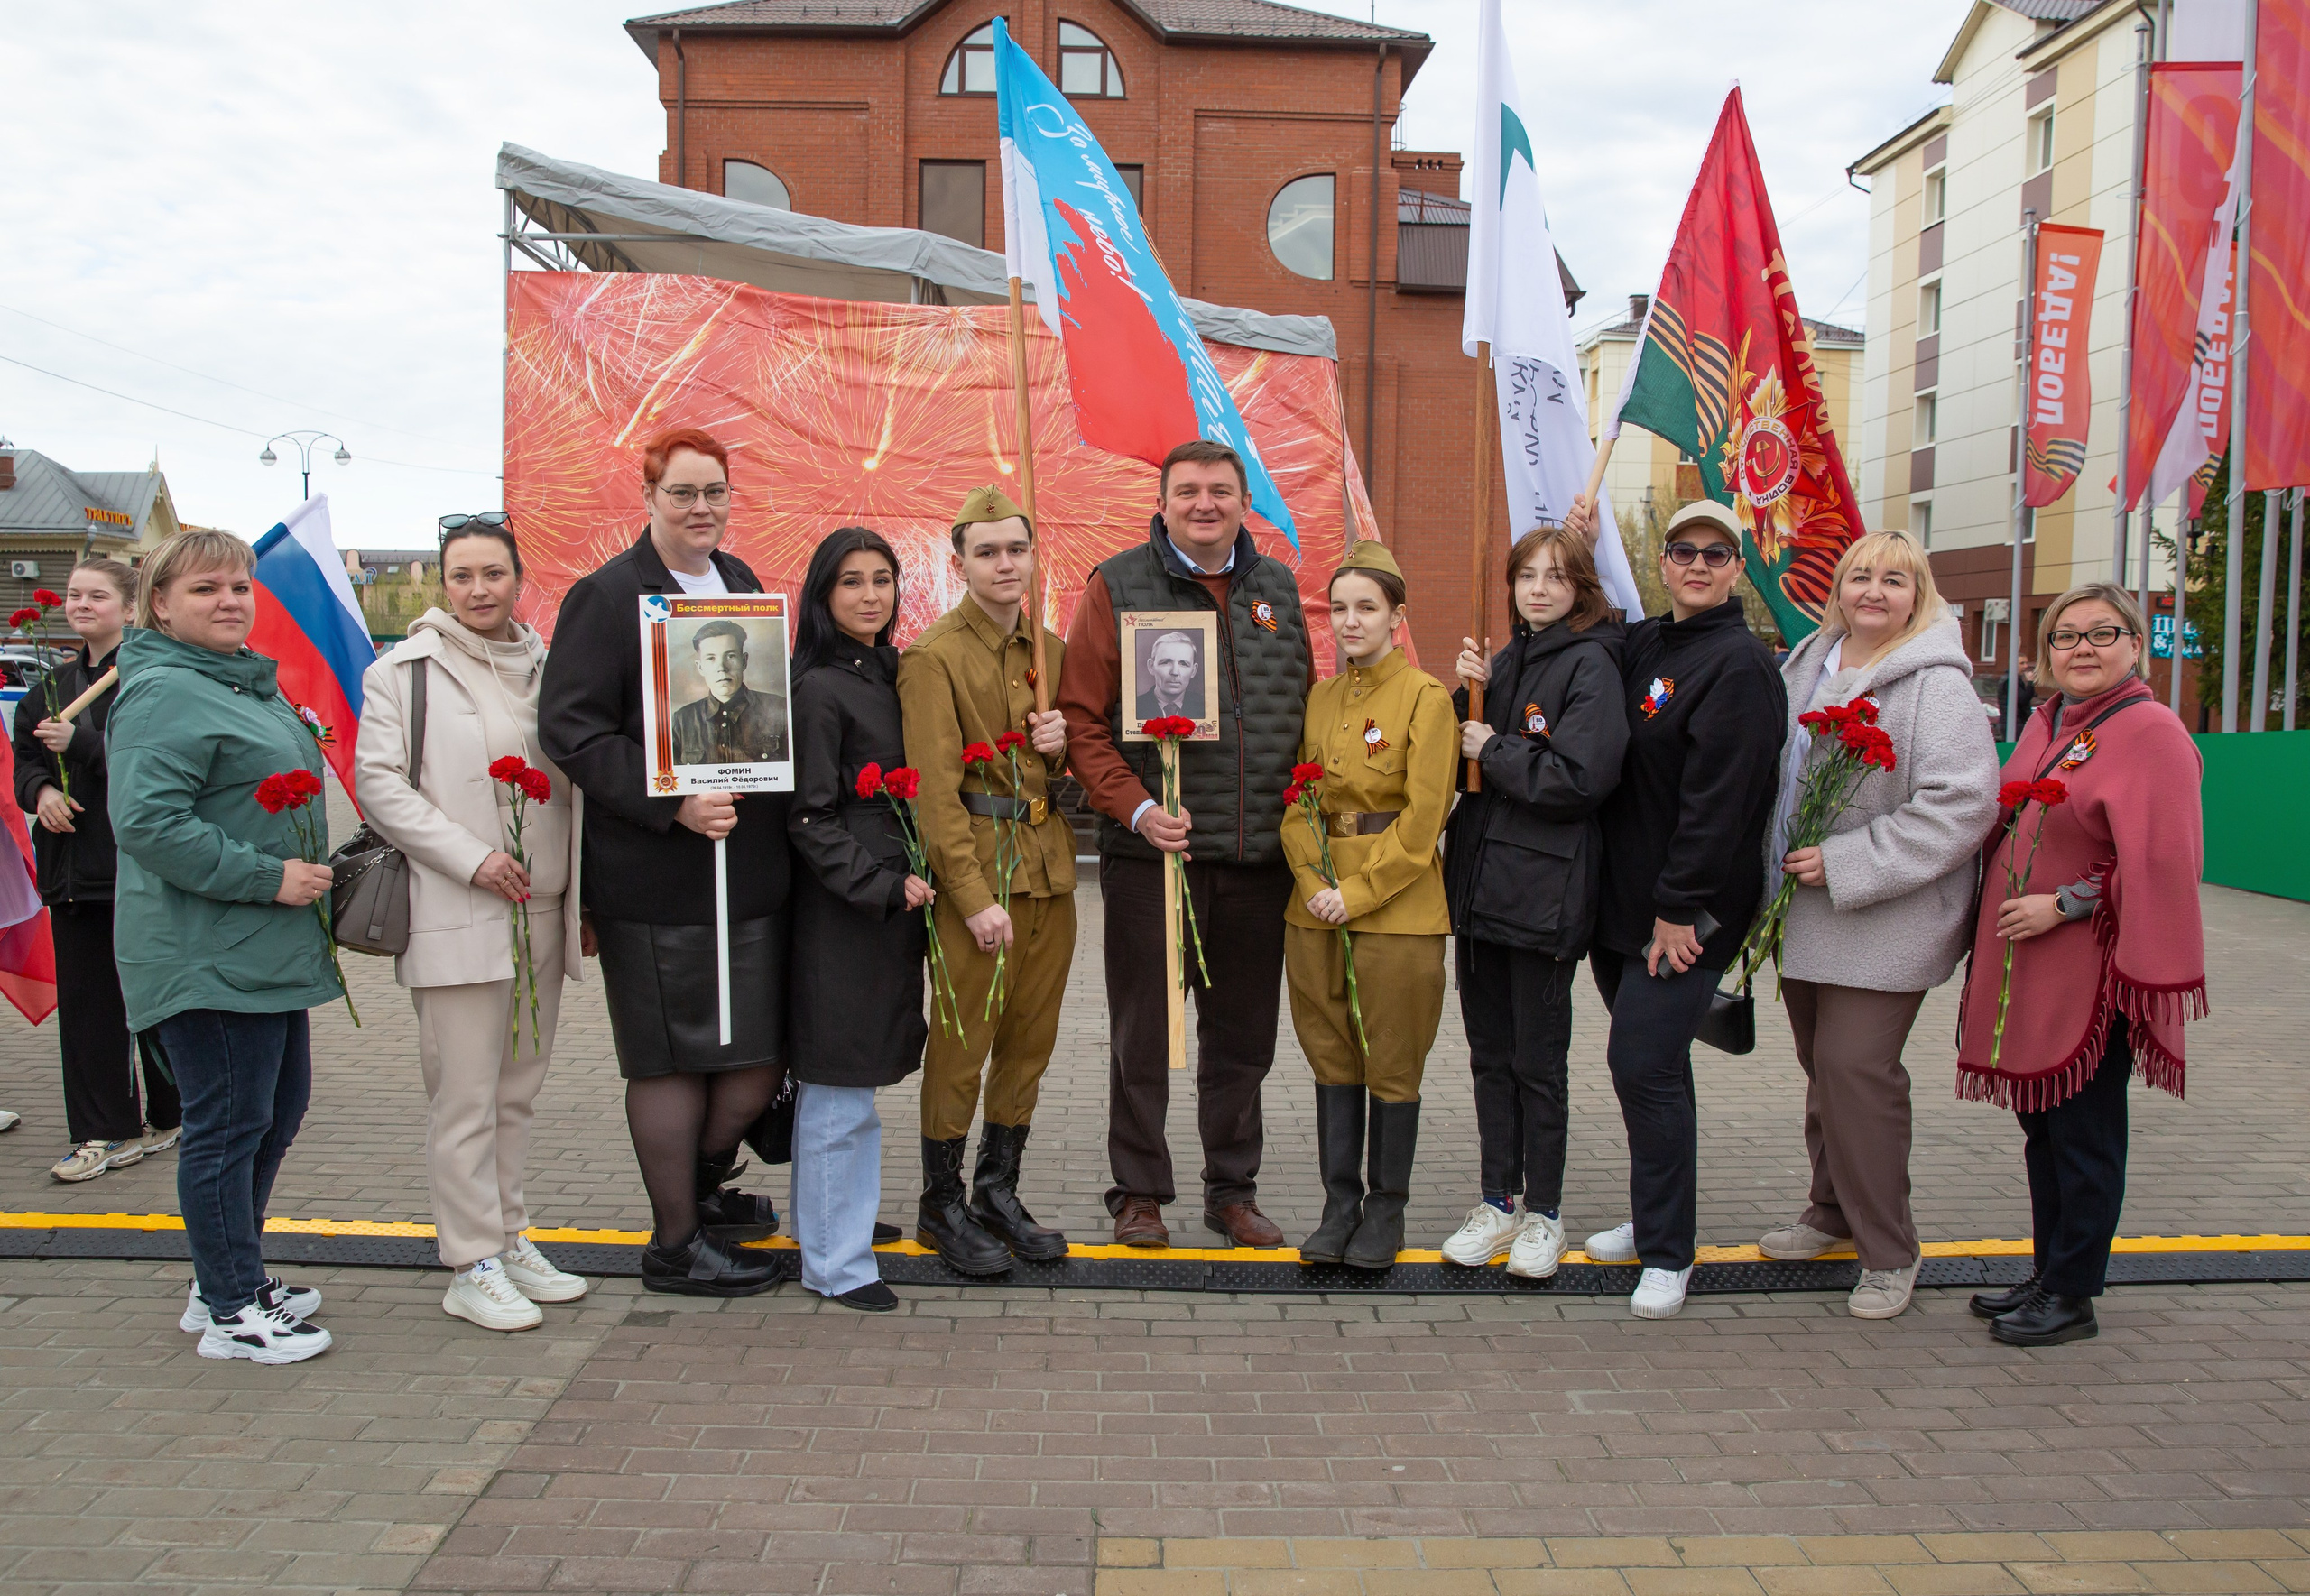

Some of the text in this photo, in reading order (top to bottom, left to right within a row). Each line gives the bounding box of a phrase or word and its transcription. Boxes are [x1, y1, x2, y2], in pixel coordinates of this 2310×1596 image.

[1027, 103, 1141, 254] За мирное
[1078, 208, 1154, 302] небо!
[1740, 420, 1798, 480] ОТЕЧЕСТВЕННАЯ
[84, 507, 134, 526] ТРАКТИРЪ
[677, 604, 751, 613] Бессмертный
[690, 776, 729, 785] Василий
